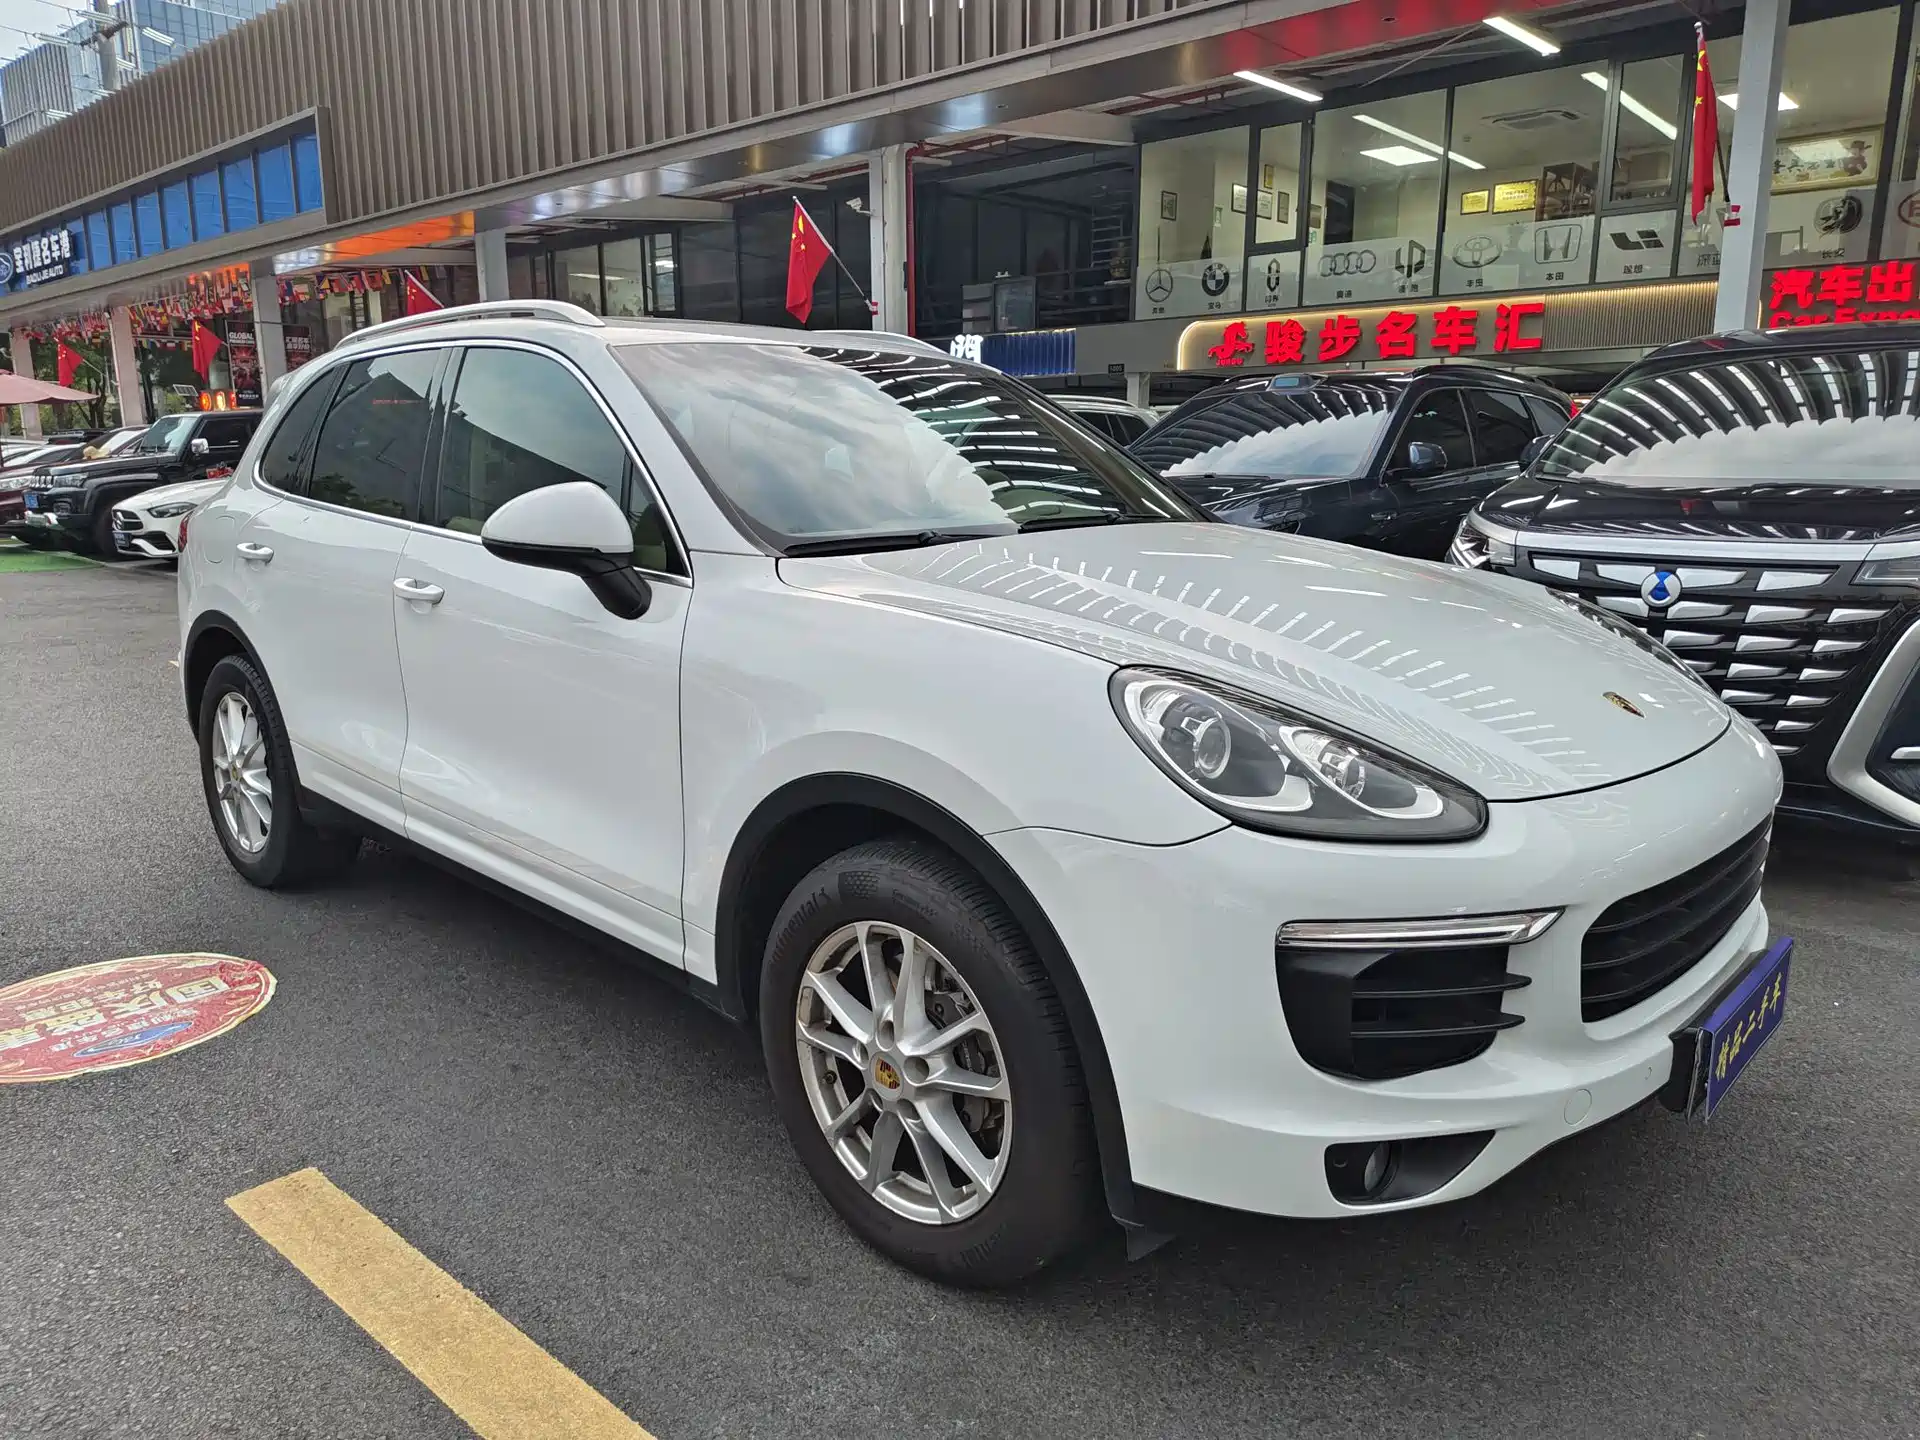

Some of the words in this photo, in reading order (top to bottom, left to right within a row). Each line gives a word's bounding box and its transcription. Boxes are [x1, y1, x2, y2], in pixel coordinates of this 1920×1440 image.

[1545, 271, 1565, 282] 本田
[1768, 260, 1920, 310] 汽车出
[228, 331, 254, 341] GLOBAL
[1264, 301, 1546, 364] 骏步名车汇
